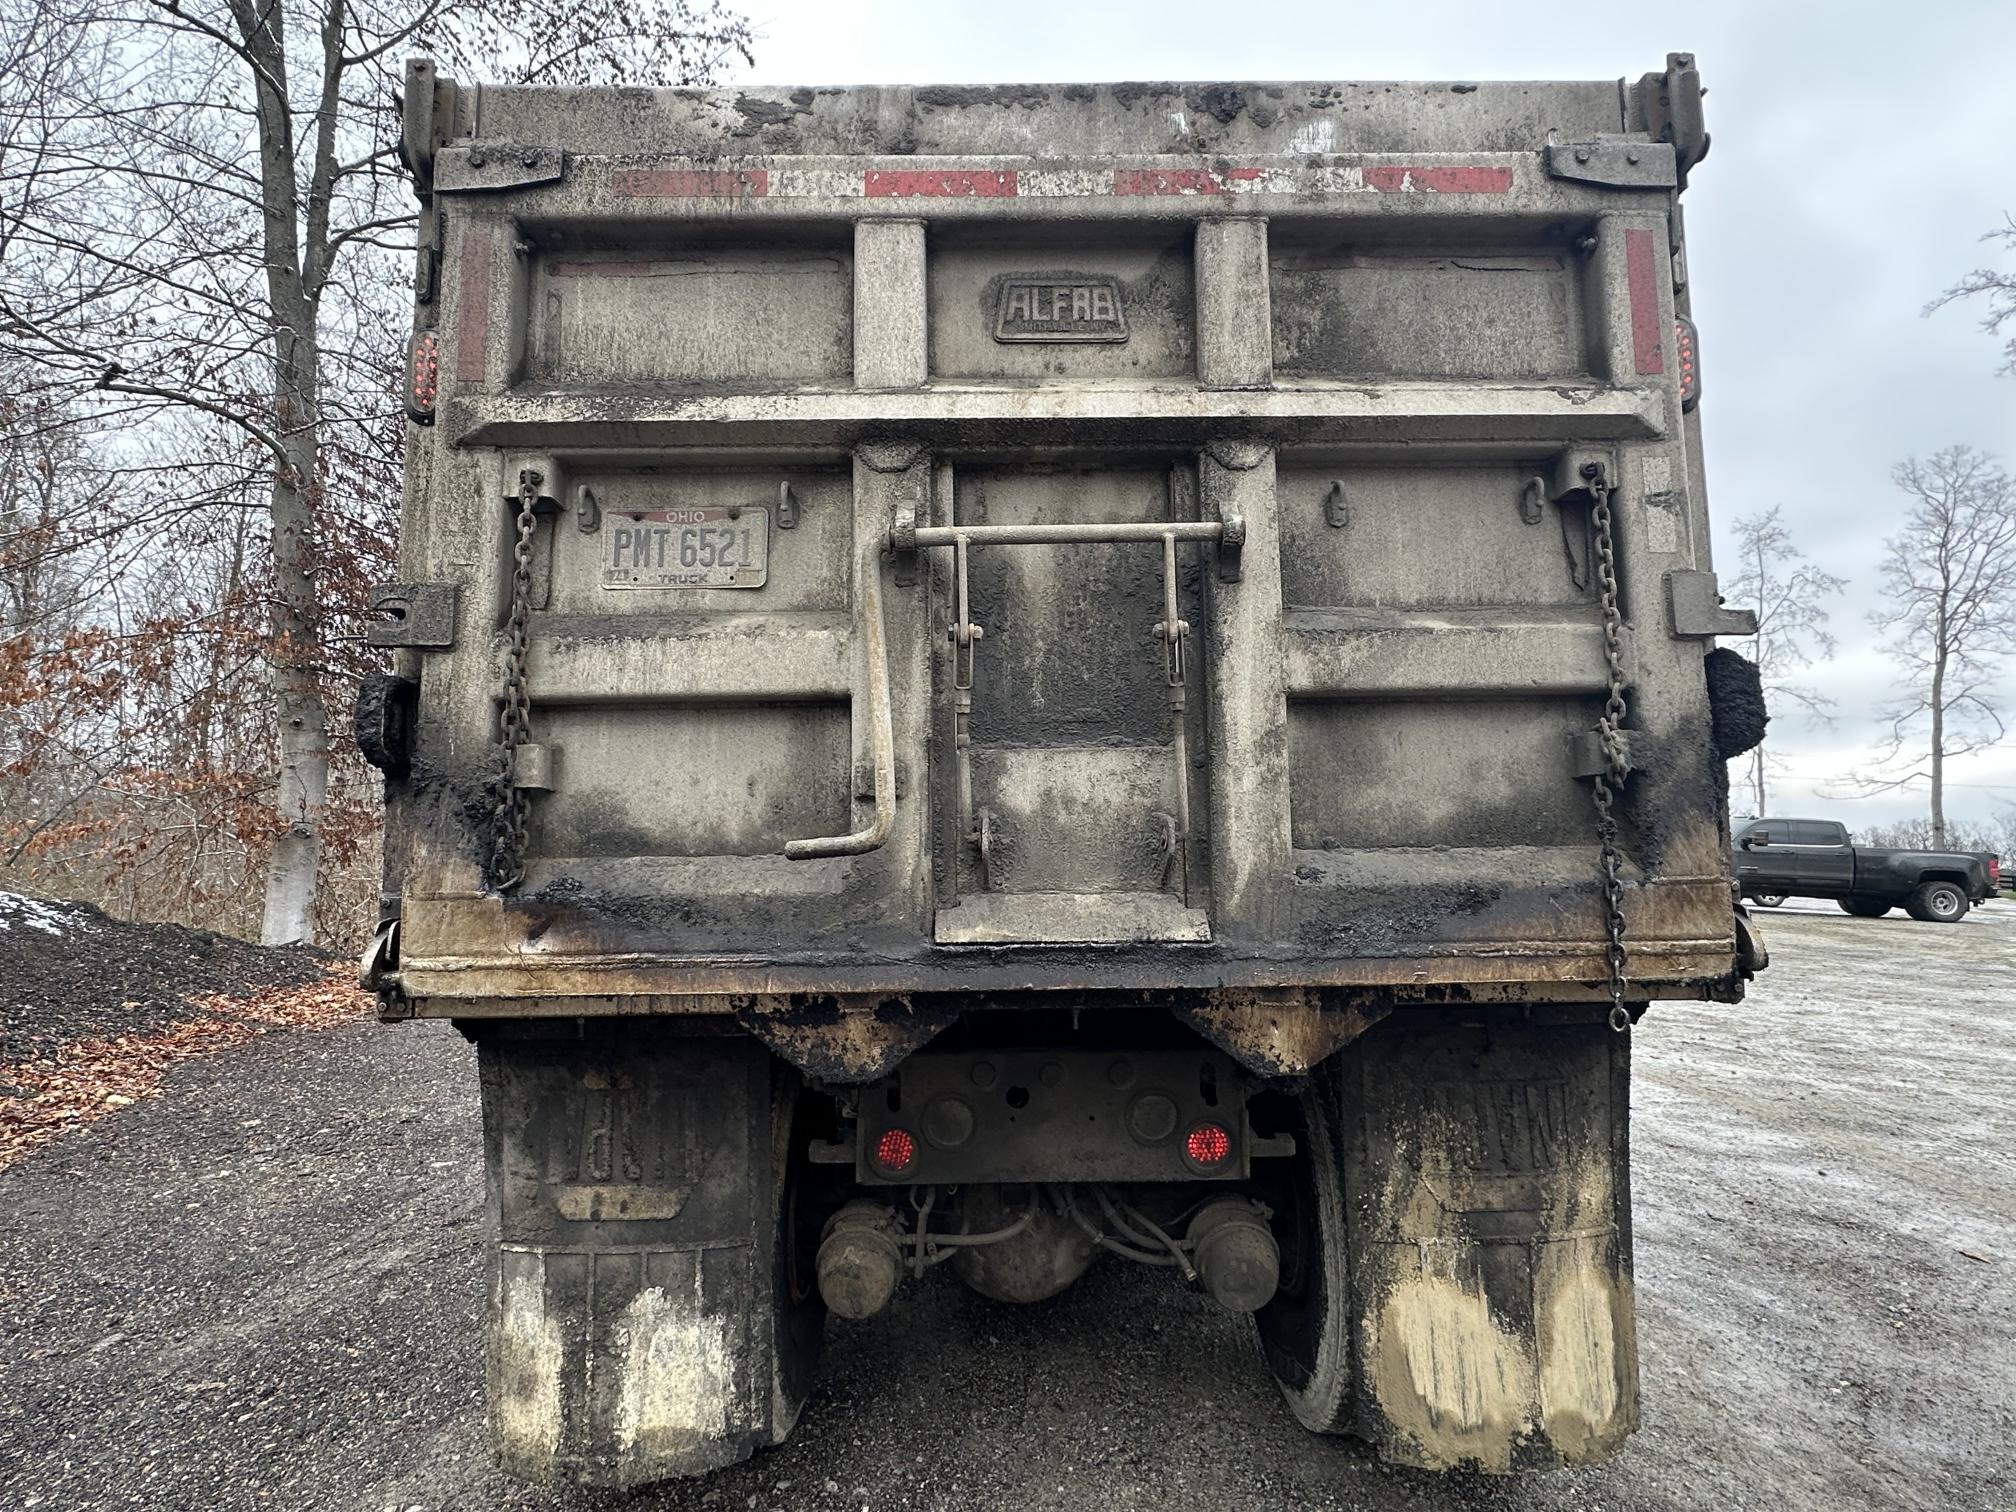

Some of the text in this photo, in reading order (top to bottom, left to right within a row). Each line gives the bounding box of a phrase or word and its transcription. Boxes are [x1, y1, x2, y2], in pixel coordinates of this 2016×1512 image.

[1006, 286, 1117, 321] ALFAB
[666, 511, 705, 523] OHIO
[613, 528, 751, 568] PMT 6521
[658, 574, 709, 585] TRUCK
